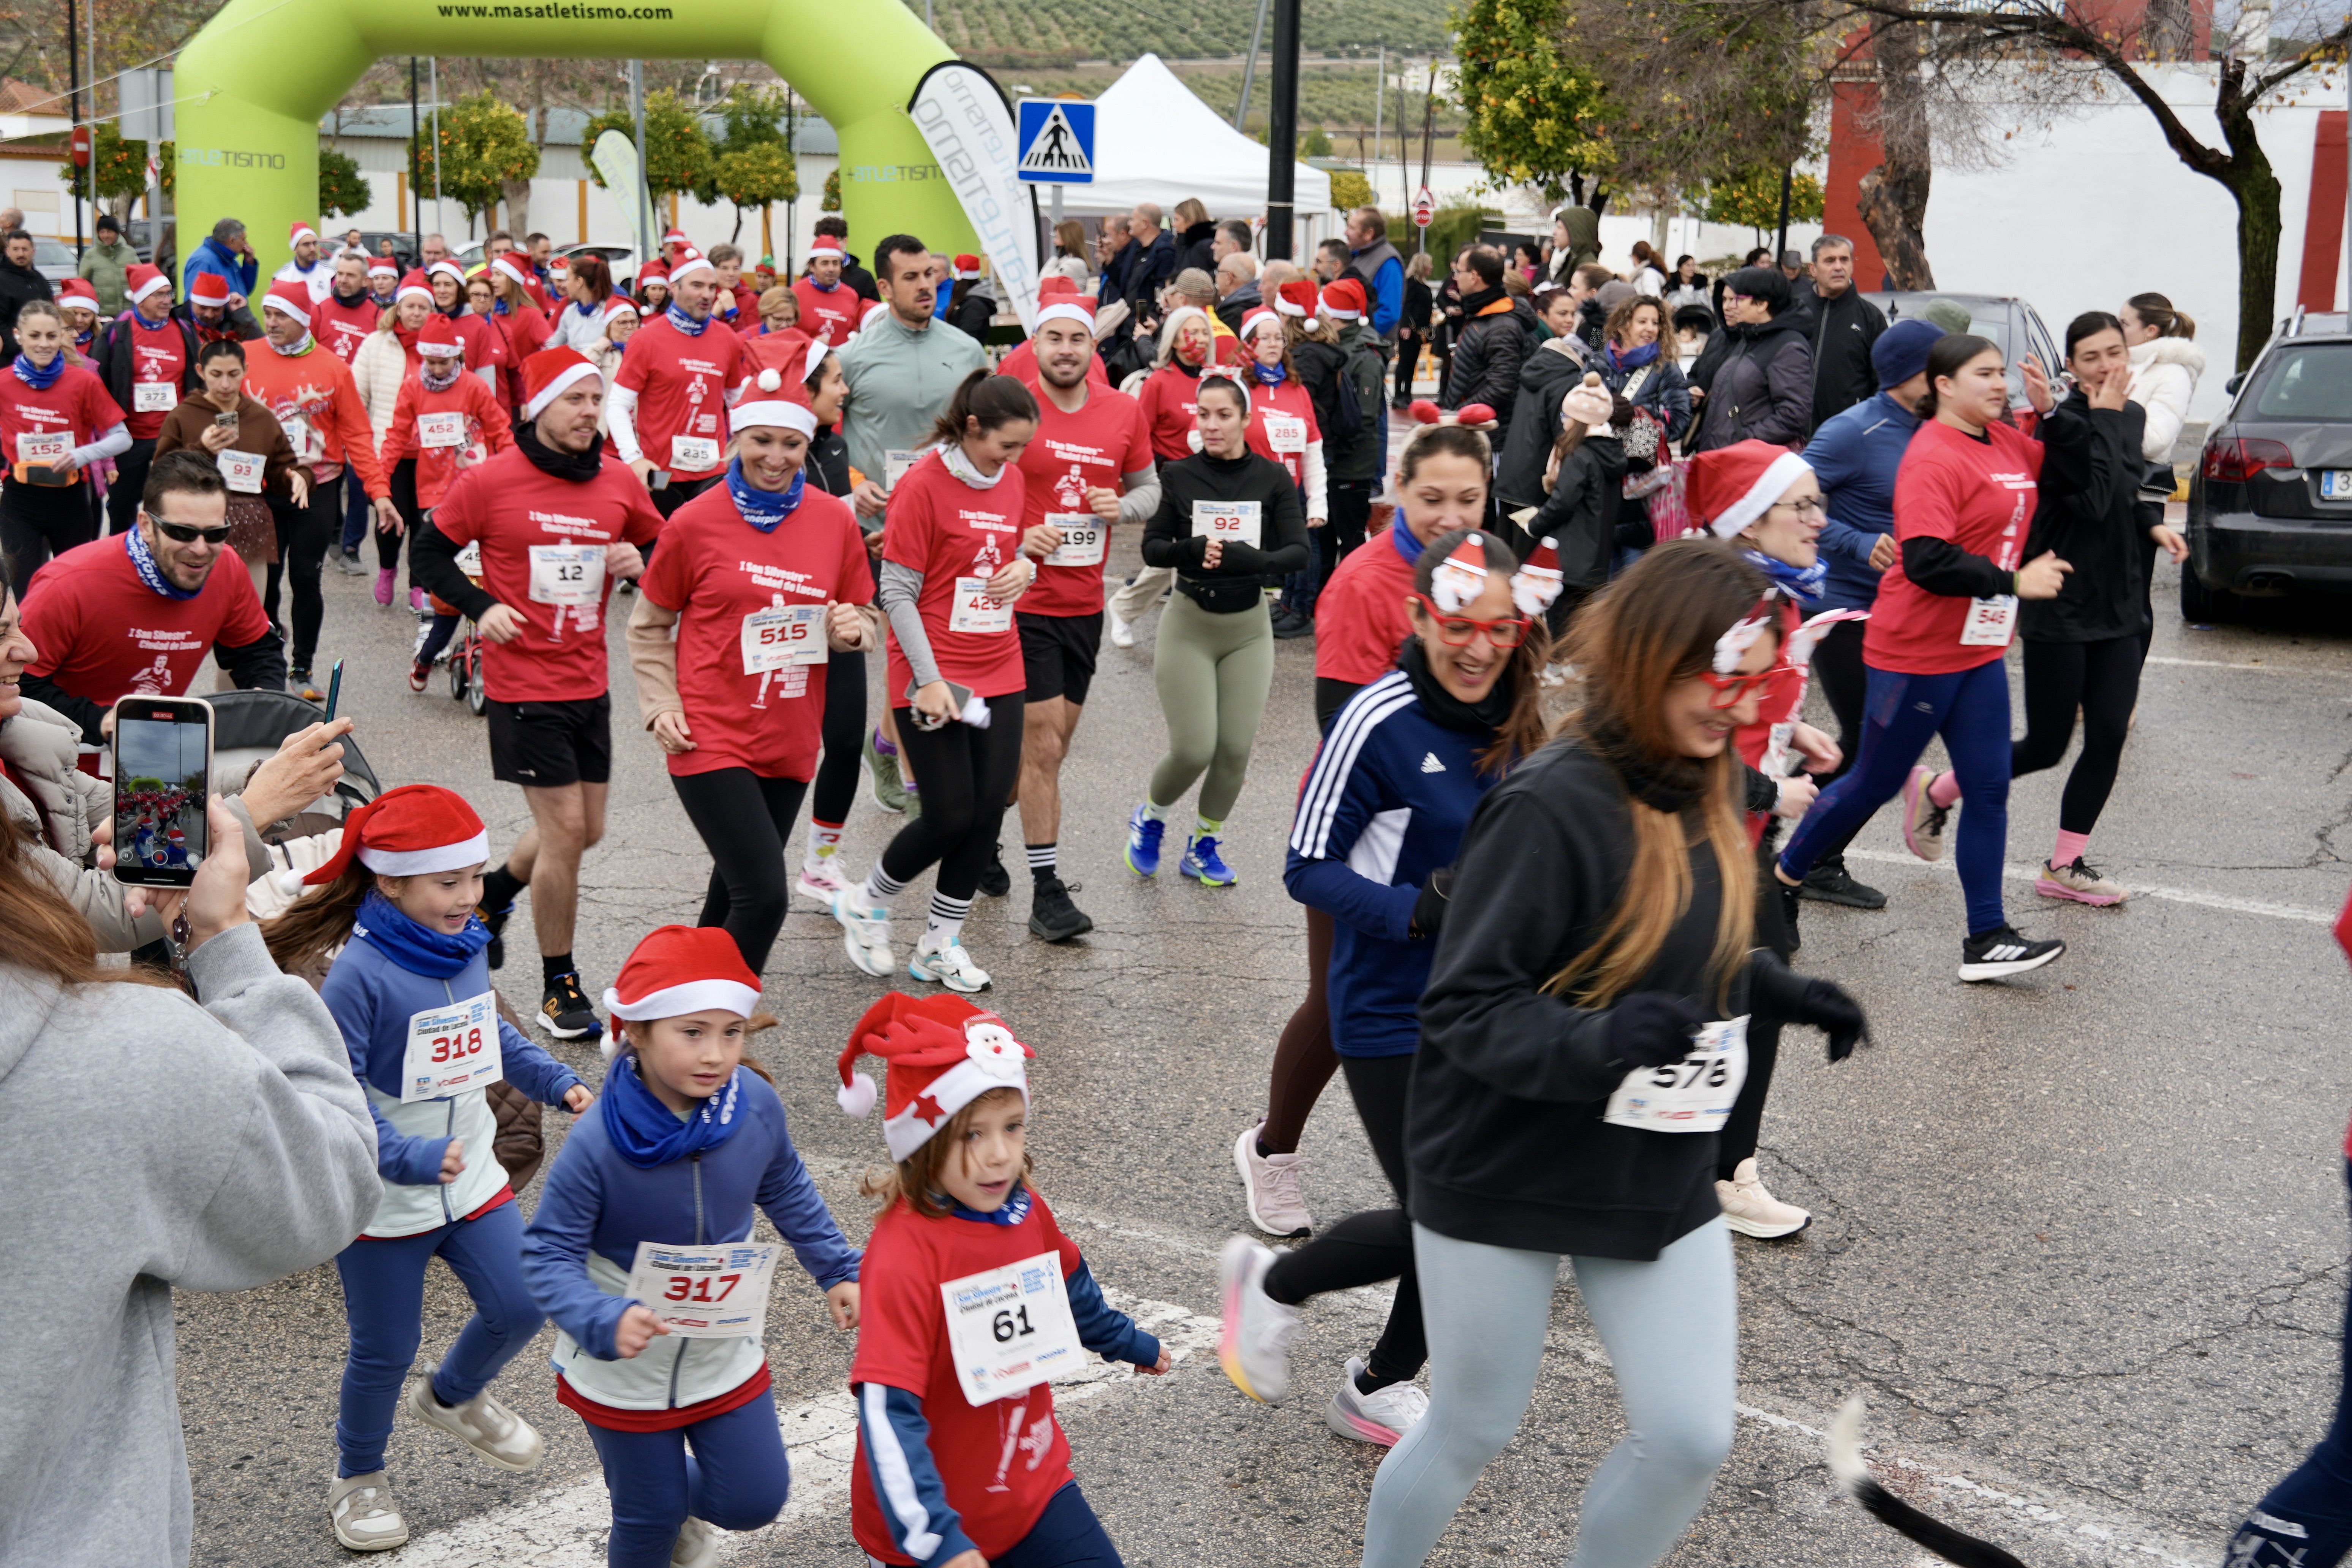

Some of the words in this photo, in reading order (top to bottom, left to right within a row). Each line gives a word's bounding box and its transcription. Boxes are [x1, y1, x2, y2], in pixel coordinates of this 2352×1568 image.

[438, 3, 673, 19] www.masatletismo.com
[428, 424, 454, 434] 452
[1276, 428, 1298, 437] 285
[32, 444, 63, 455] 152
[683, 449, 709, 459] 235
[234, 464, 252, 476] 93
[1215, 517, 1240, 530] 92
[1062, 531, 1096, 545] 199
[558, 565, 583, 580] 12
[969, 596, 1002, 610] 429
[760, 623, 808, 645] 515
[431, 1028, 482, 1062] 318
[663, 1274, 742, 1302] 317
[994, 1303, 1035, 1343] 61
